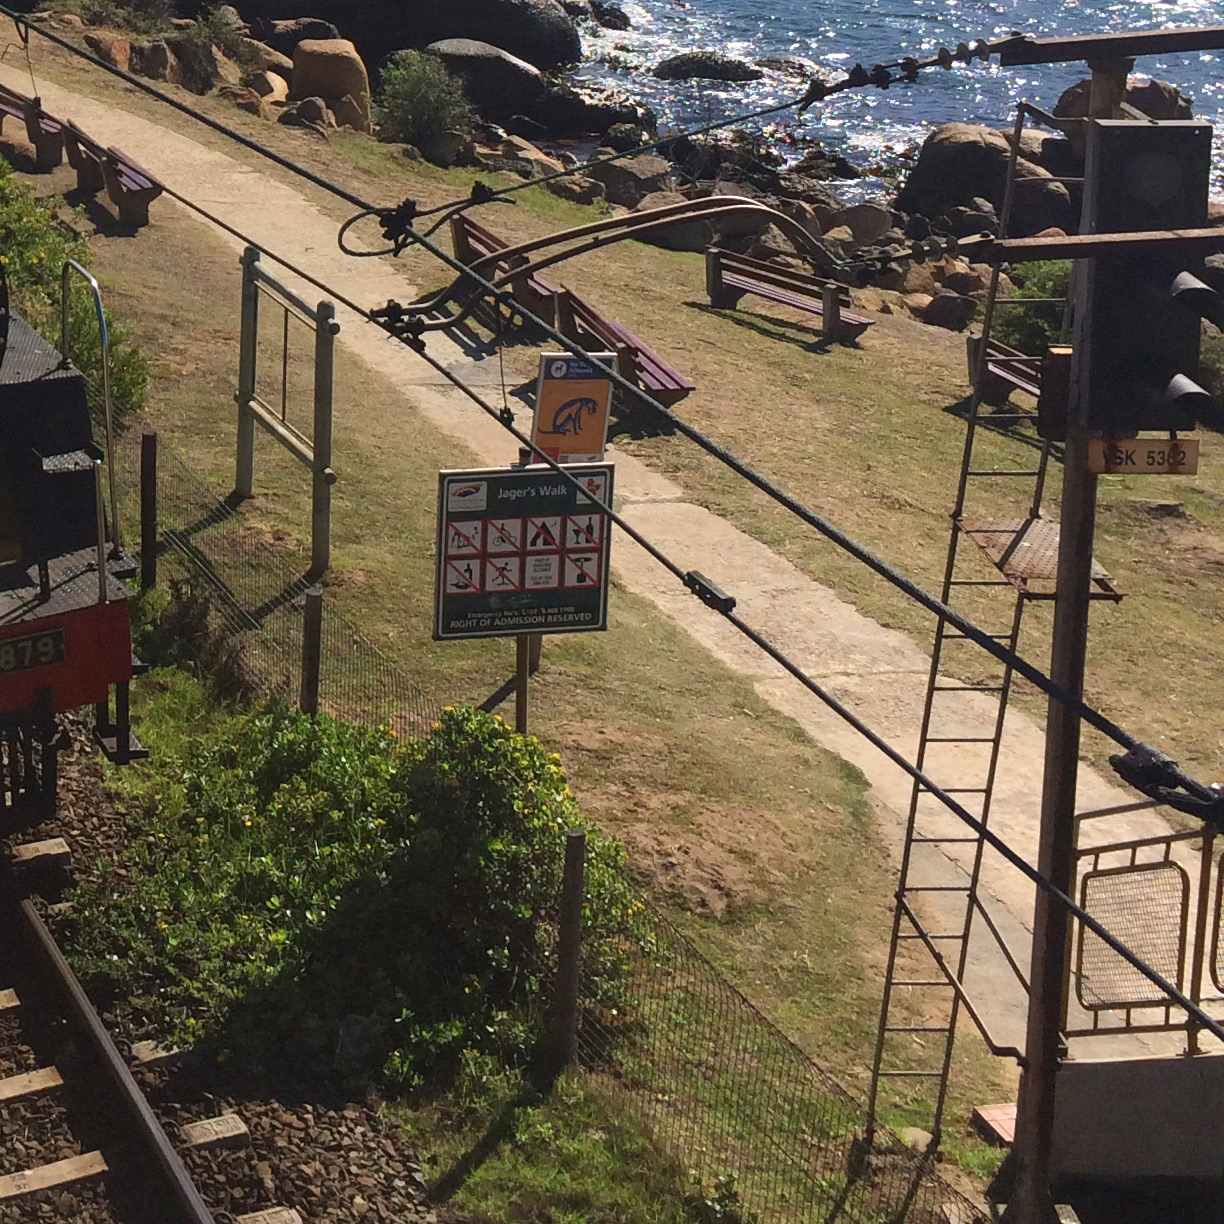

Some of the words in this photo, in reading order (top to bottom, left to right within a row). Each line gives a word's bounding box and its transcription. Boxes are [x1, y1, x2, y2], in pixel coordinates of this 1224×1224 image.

[497, 486, 536, 501] Jager's
[539, 484, 568, 496] Walk
[450, 618, 477, 628] RIGHT
[479, 618, 491, 626] OF
[493, 615, 545, 626] ADMISSION
[547, 612, 593, 623] RESERVED
[0, 636, 55, 671] 879
